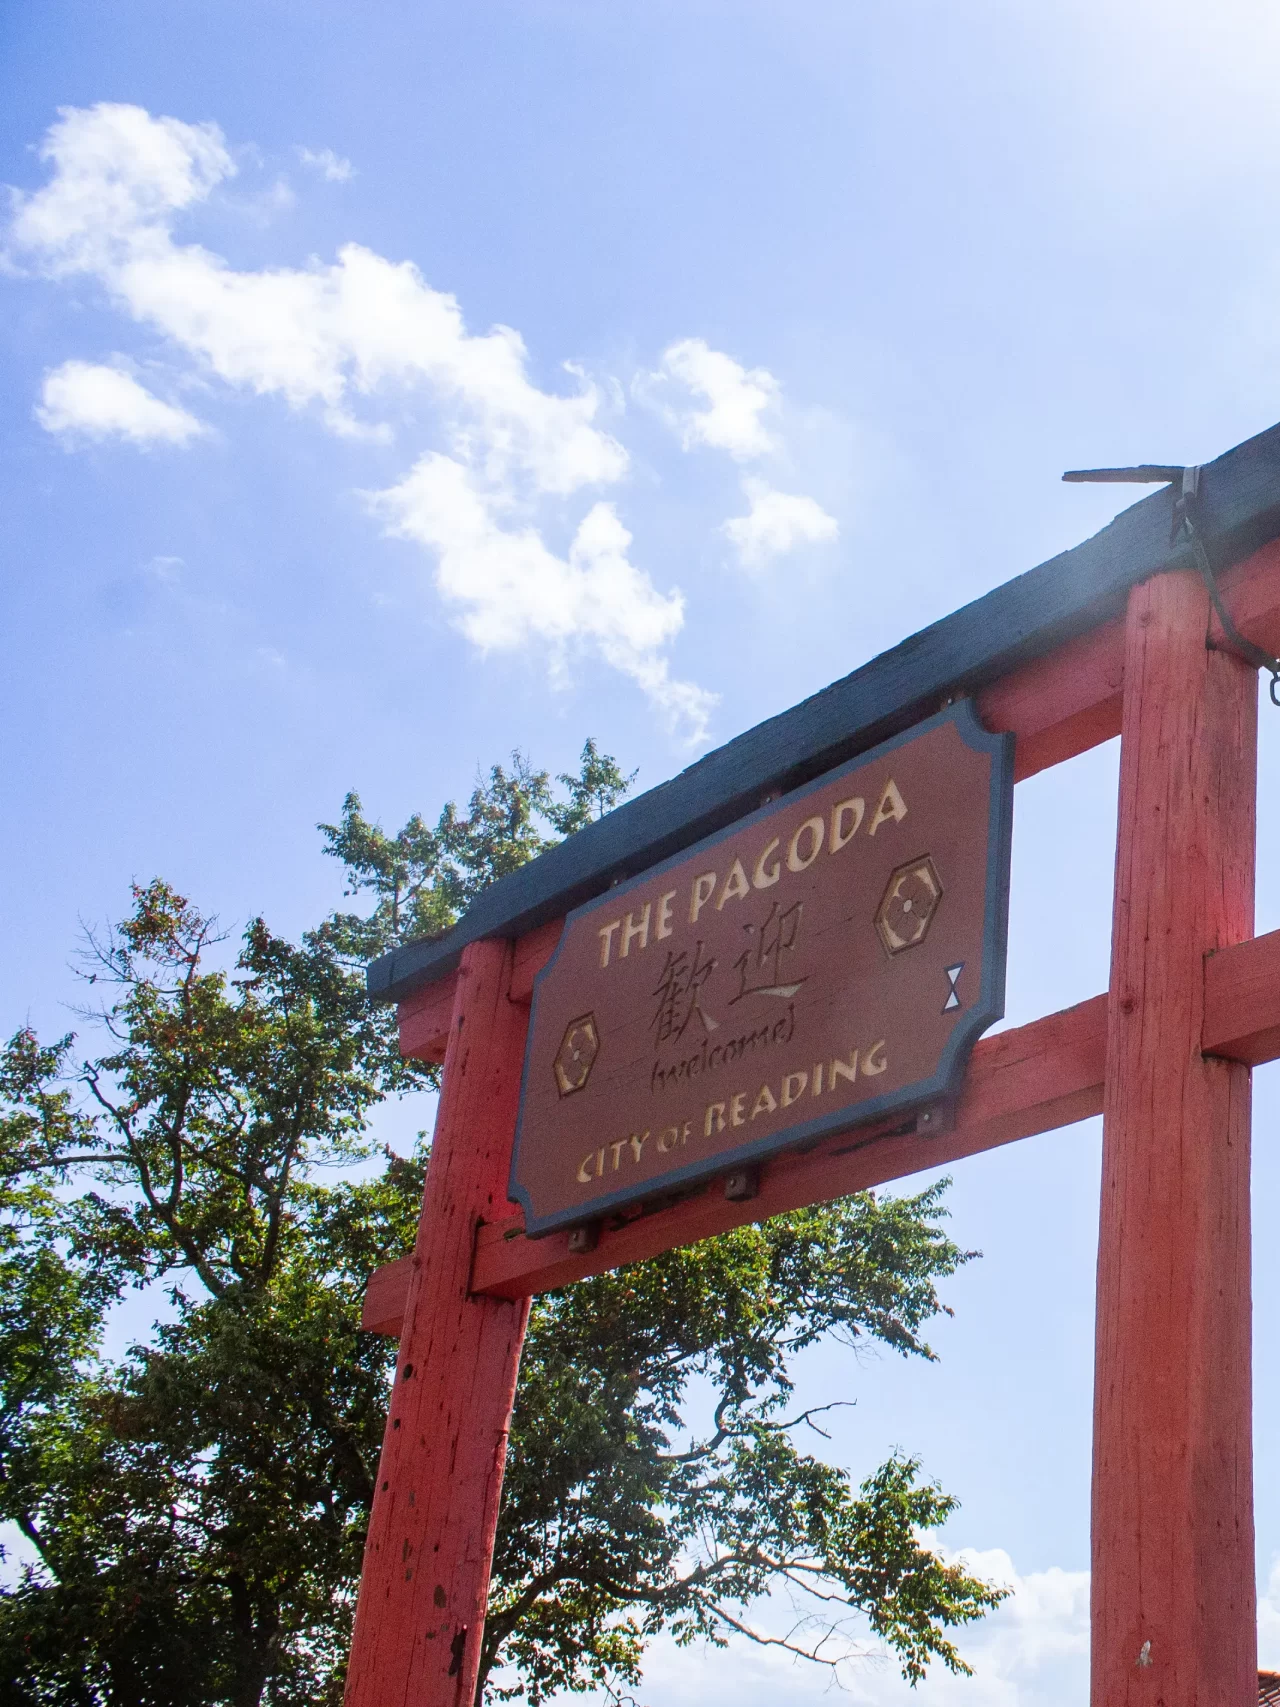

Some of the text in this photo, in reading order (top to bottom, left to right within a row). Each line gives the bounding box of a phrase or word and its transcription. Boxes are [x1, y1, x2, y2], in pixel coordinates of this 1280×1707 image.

[598, 775, 909, 968] THE PAGODA
[576, 1039, 889, 1183] CITY OF READING
